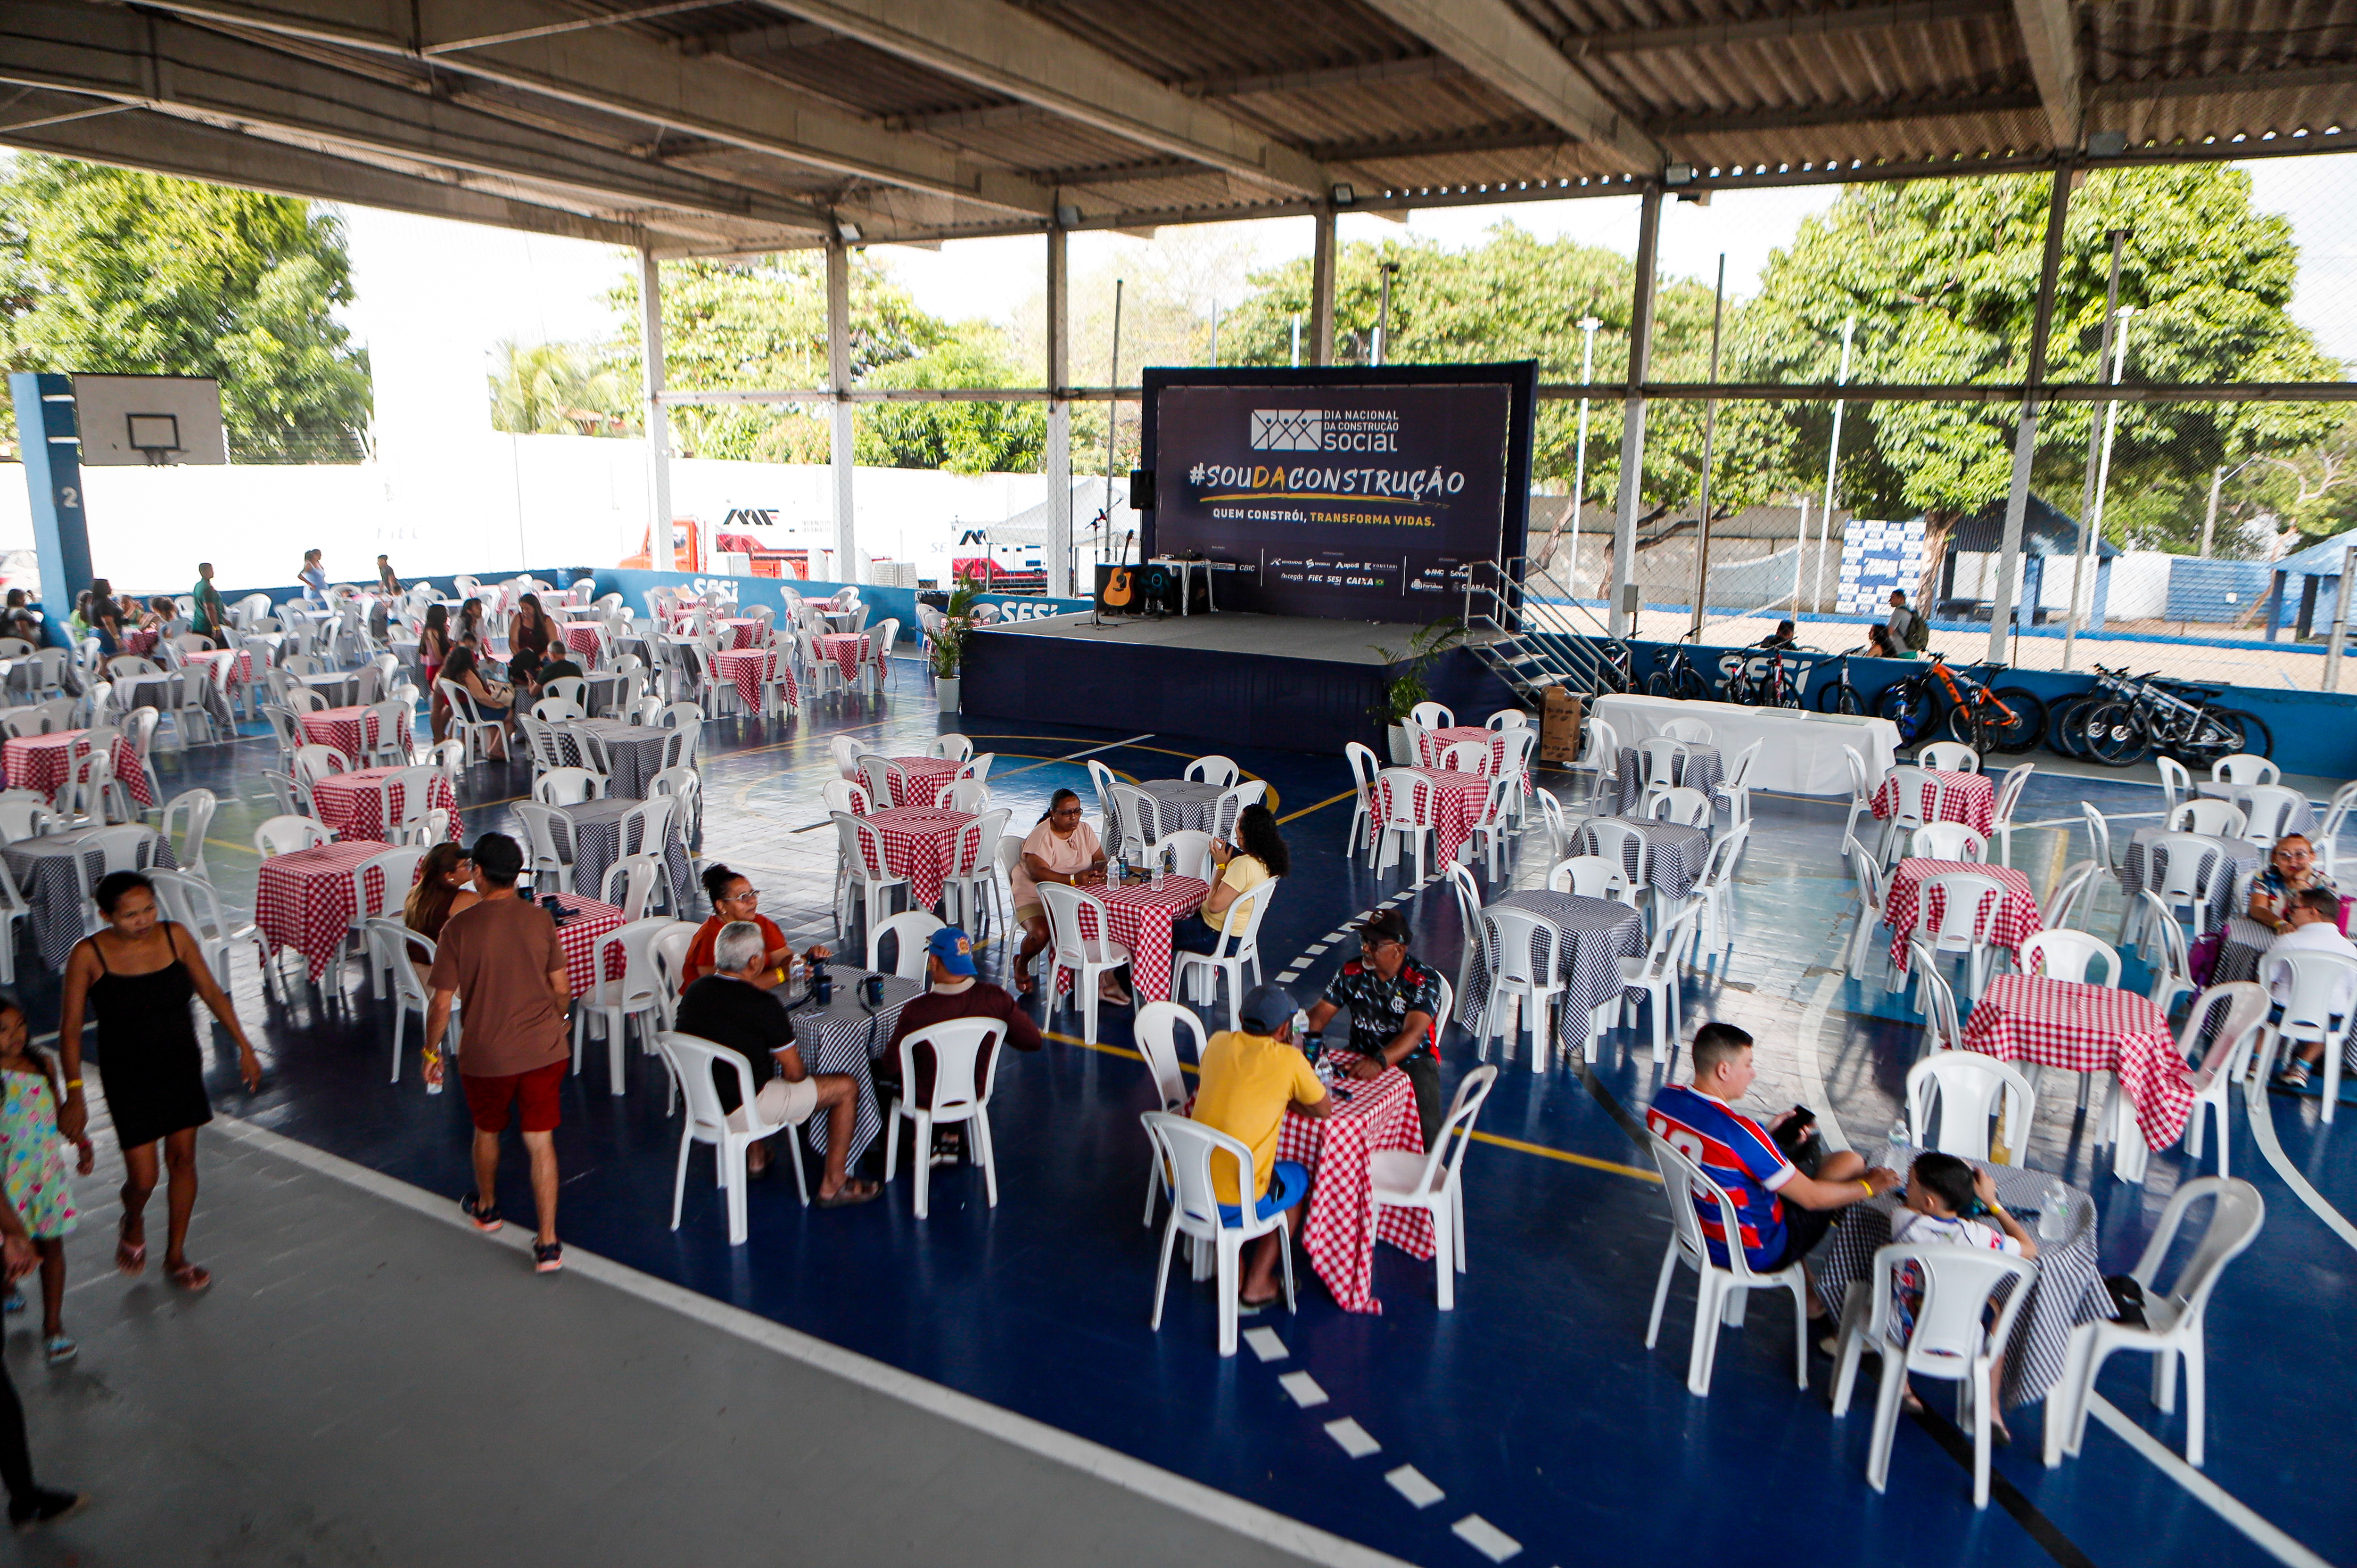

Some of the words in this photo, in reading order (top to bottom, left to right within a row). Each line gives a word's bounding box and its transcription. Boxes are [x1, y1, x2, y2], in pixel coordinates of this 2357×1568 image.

[1324, 410, 1341, 419] DIA
[1345, 410, 1399, 420] NACIONAL
[1324, 422, 1336, 431] DA
[1338, 420, 1399, 433] CONSTRUÇÃO
[1189, 462, 1465, 501] #SOUDACONSTRUÇÃO
[62, 486, 79, 508] 2
[1213, 508, 1244, 519] QUEM
[1247, 509, 1307, 524] CONSTRÓI,
[1310, 512, 1391, 525] TRANSFORMA
[1394, 515, 1435, 527] VIDAS.
[1346, 576, 1374, 586] CAIXA
